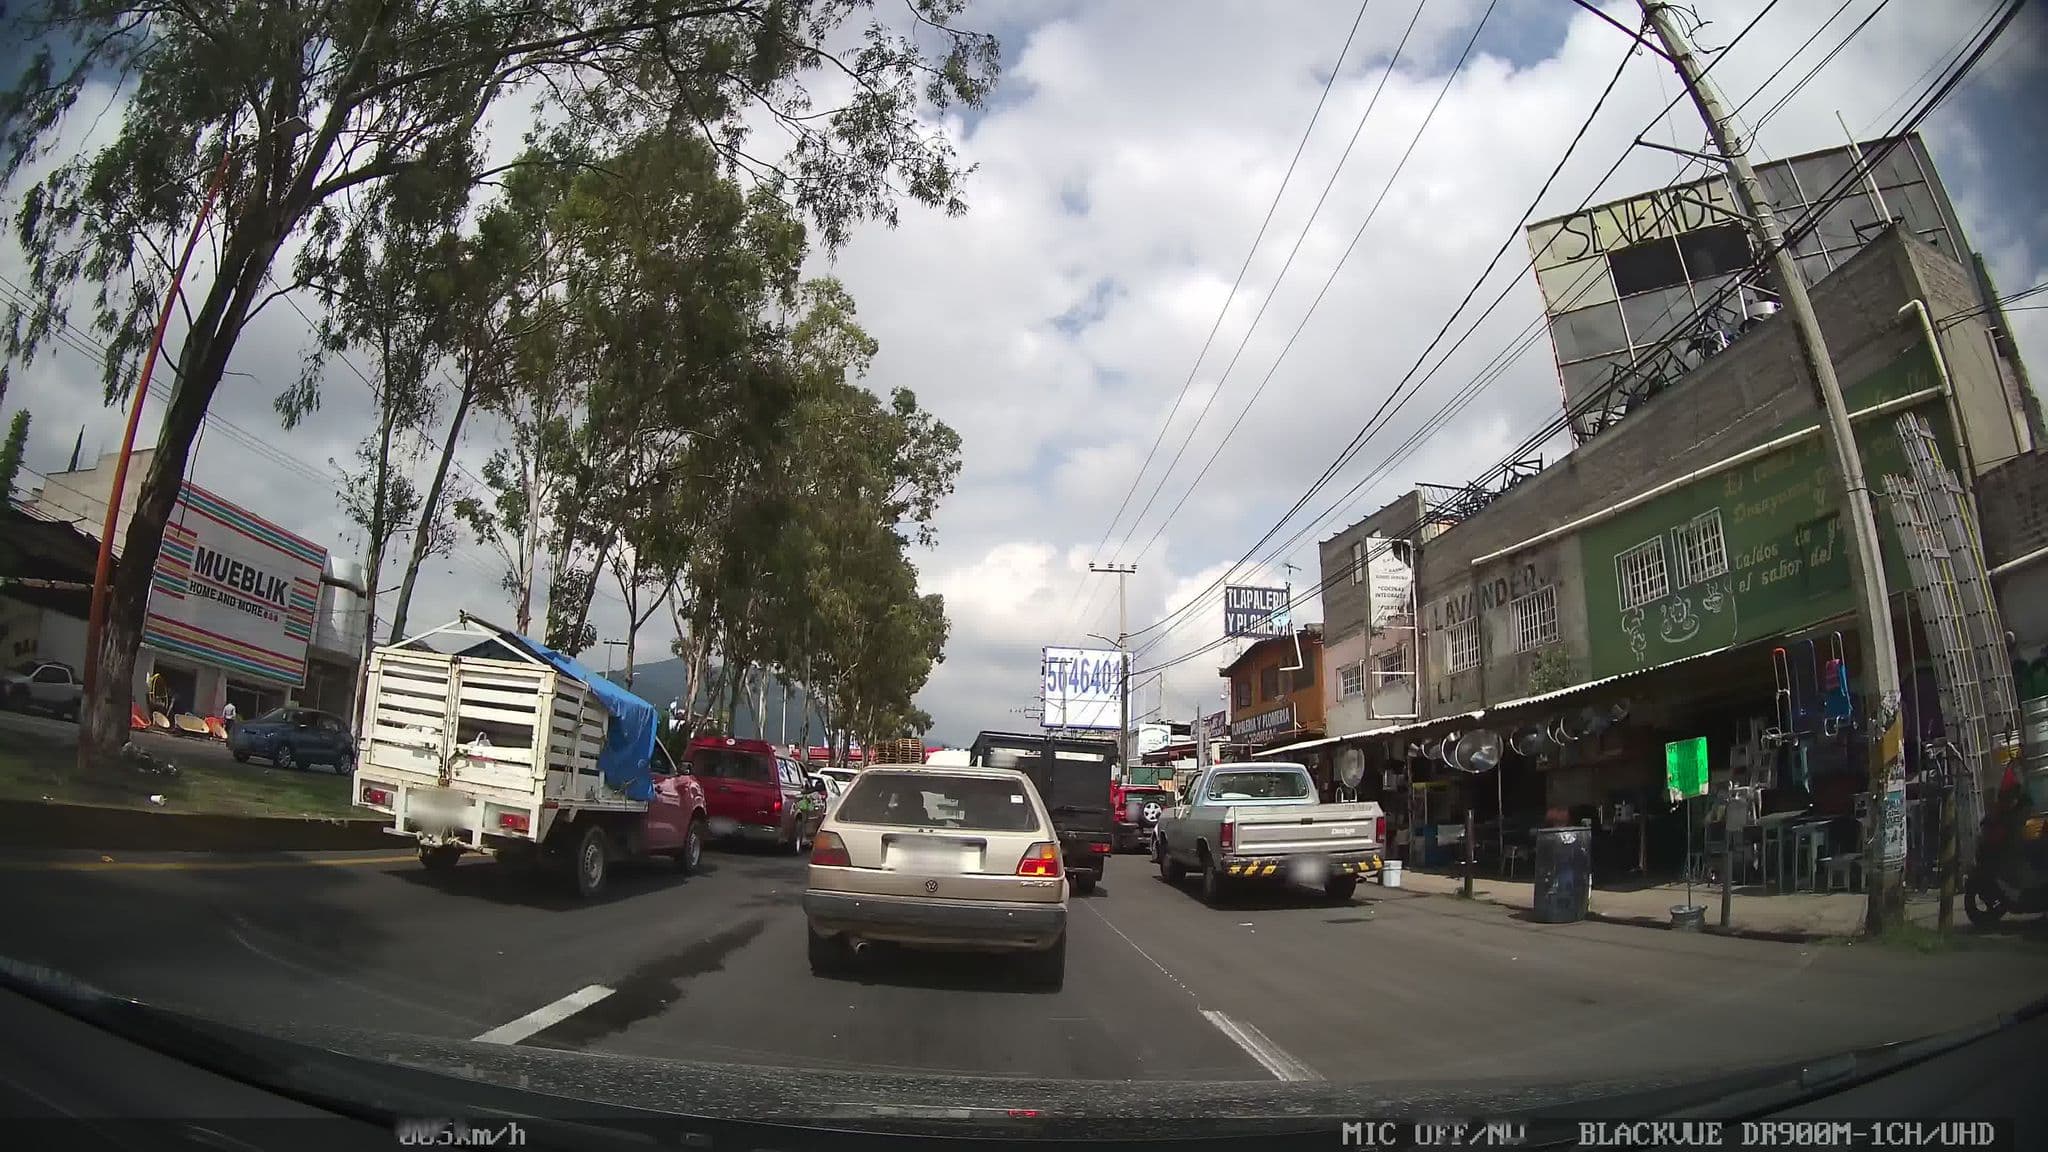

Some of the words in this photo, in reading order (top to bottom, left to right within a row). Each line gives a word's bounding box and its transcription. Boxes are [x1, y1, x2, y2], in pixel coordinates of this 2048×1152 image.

[1606, 182, 1732, 245] VENDE
[194, 546, 289, 606] MUEBLIK
[189, 580, 218, 600] HOME
[217, 592, 237, 607] AND
[1226, 588, 1289, 611] TLAPALERIA
[1227, 613, 1235, 633] Y
